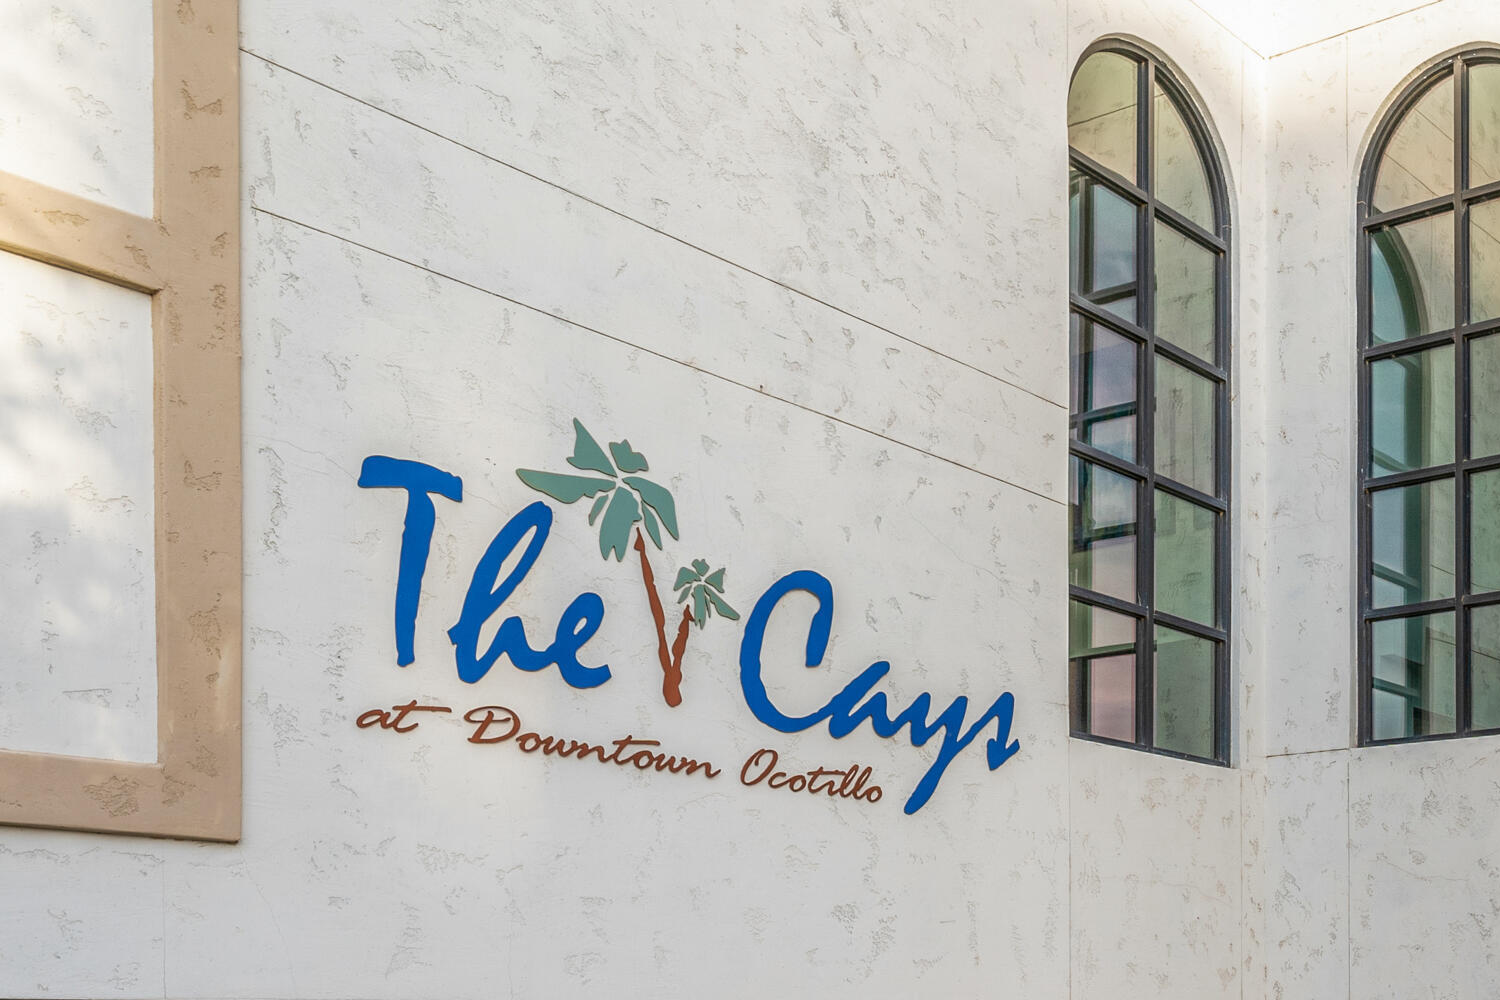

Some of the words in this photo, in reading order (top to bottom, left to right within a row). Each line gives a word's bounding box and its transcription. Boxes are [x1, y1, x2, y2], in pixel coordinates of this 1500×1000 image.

[356, 699, 453, 734] at
[463, 705, 722, 780] Downtown
[740, 748, 884, 803] Ocotillo
[357, 455, 611, 688] The
[739, 569, 1021, 815] Cays
